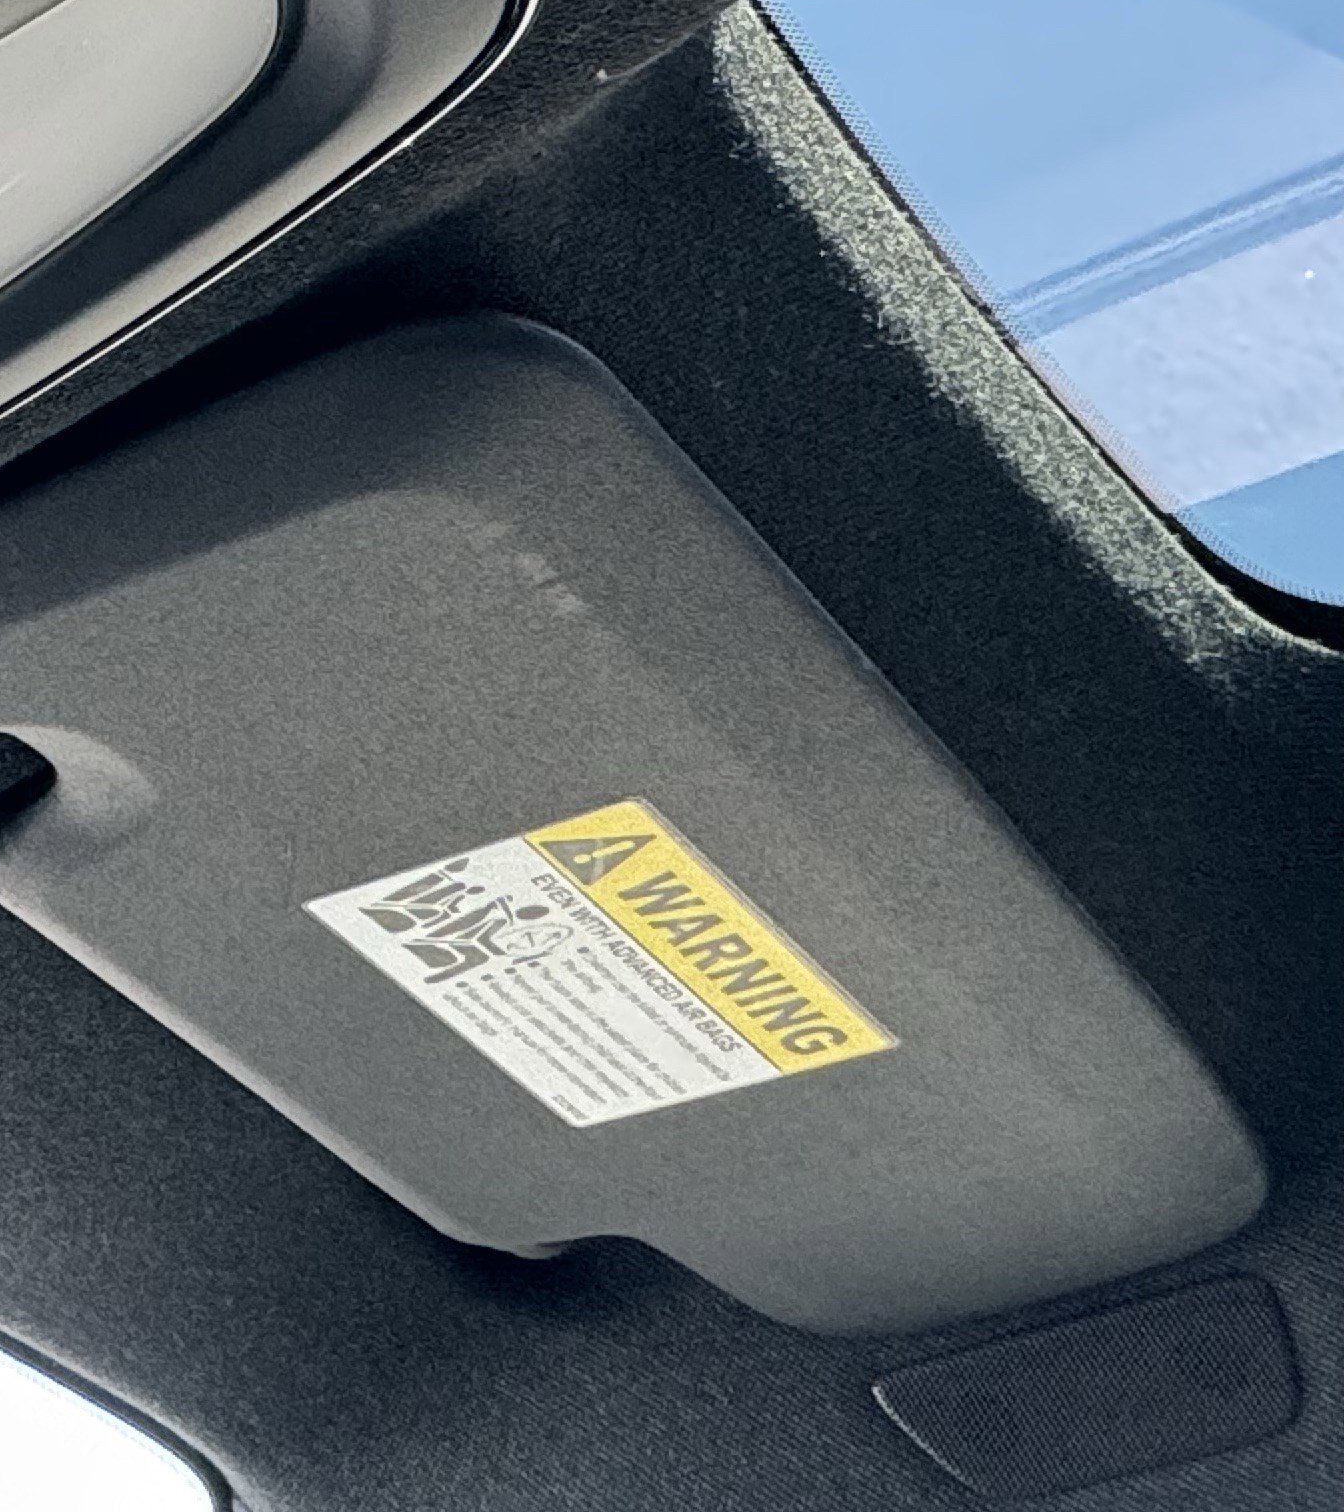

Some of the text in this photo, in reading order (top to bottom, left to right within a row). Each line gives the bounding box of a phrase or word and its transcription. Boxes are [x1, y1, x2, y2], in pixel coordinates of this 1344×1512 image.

[530, 872, 578, 910] EVEN
[569, 905, 616, 946] WITH
[601, 939, 685, 1003] ADVANCED
[670, 1000, 706, 1022] AIR
[694, 1020, 744, 1054] BAGS
[617, 870, 849, 1056] WARNING
